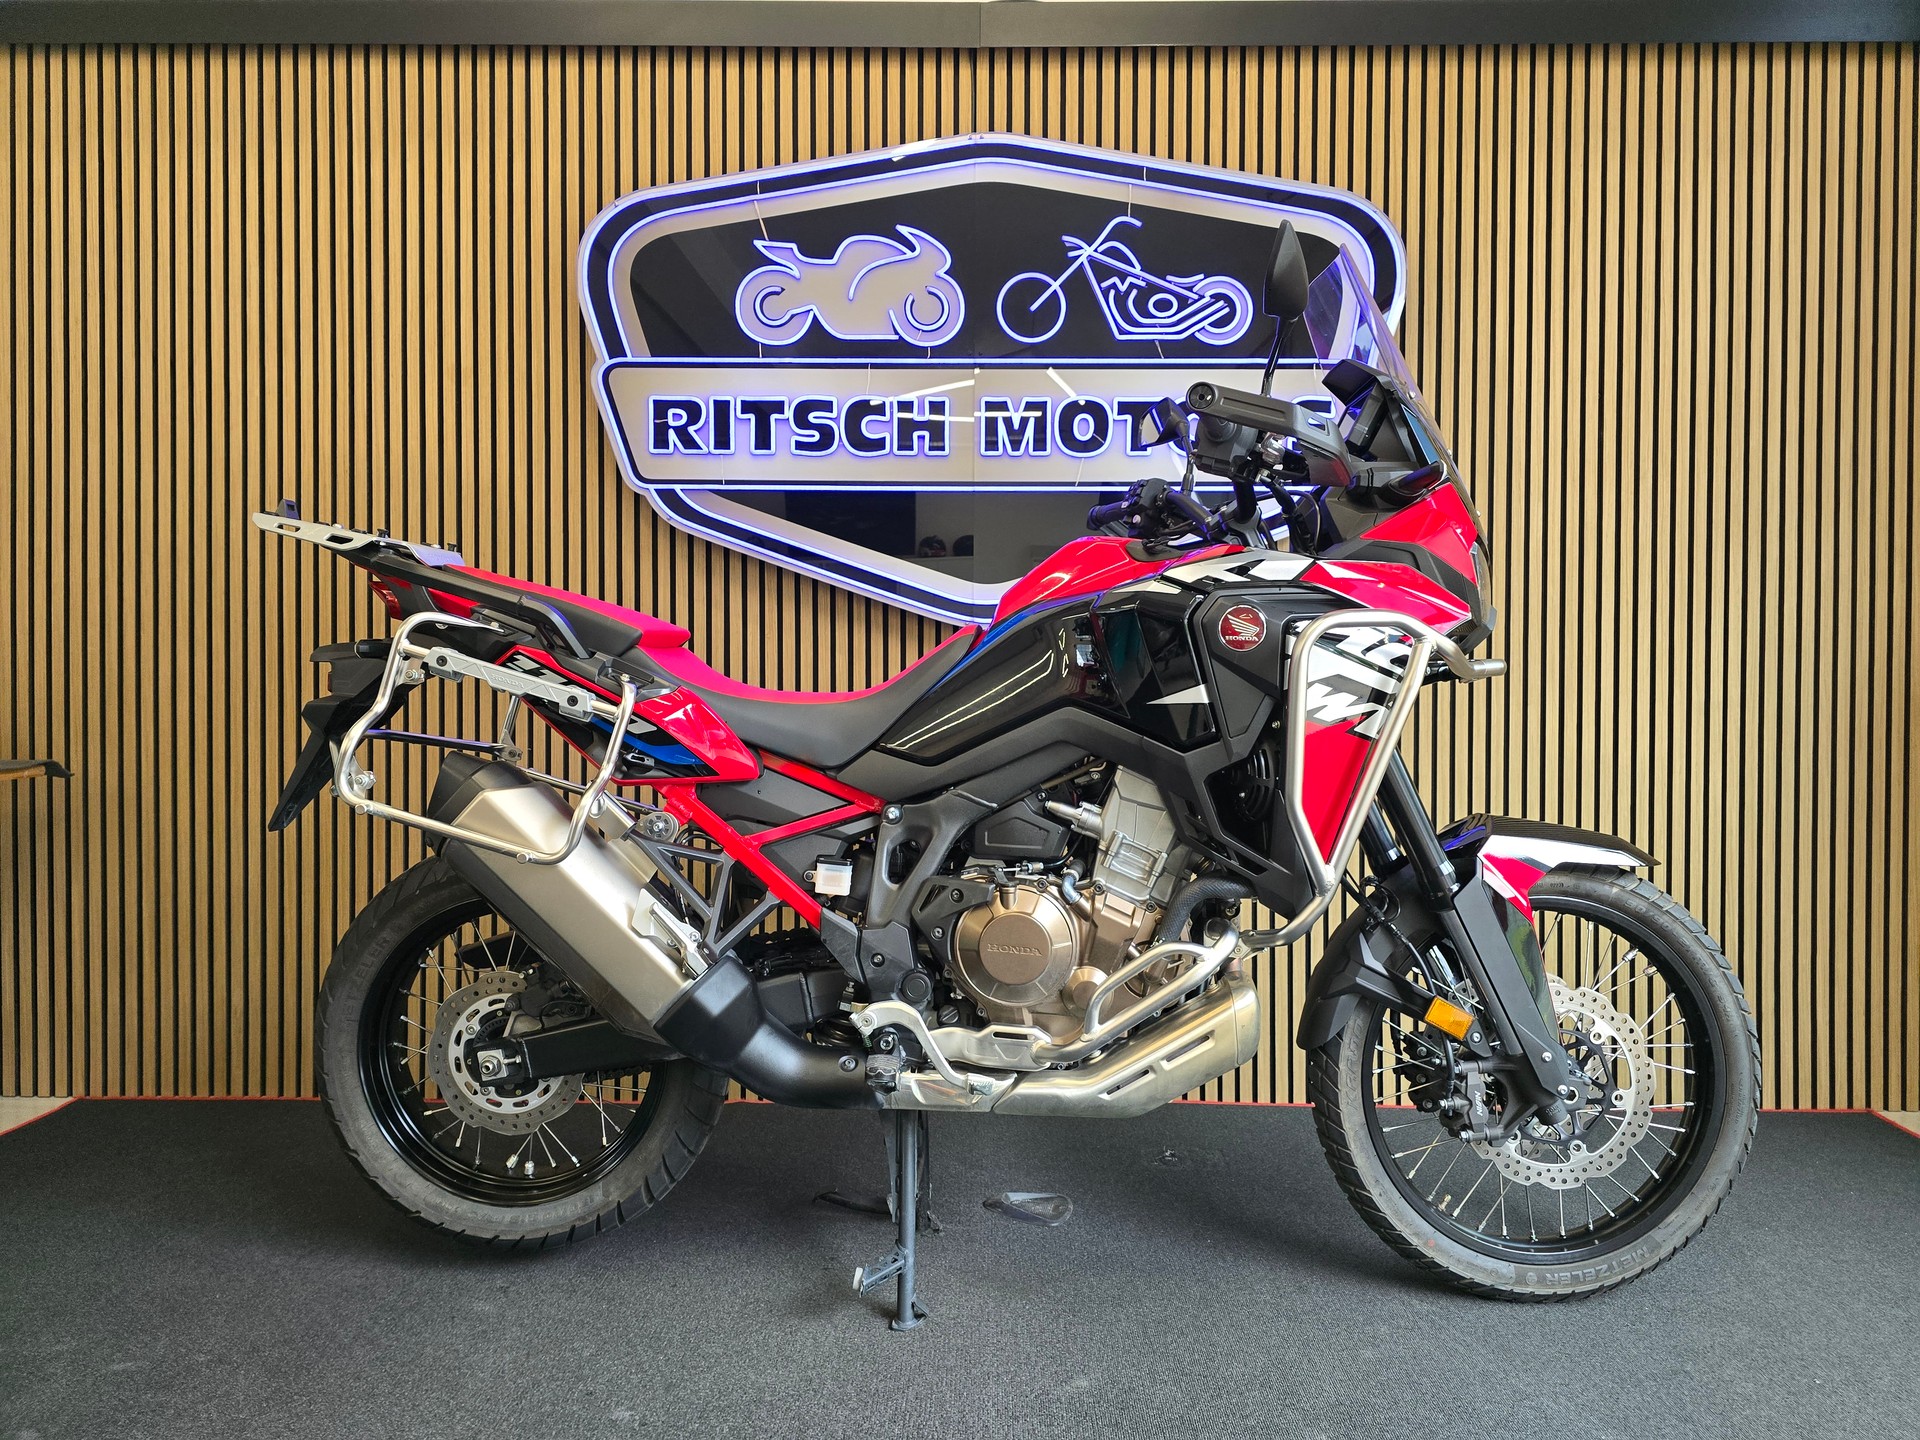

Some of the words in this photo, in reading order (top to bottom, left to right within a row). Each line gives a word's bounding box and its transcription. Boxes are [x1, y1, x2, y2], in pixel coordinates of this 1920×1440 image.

[649, 396, 950, 456] RITSCH
[979, 395, 1336, 458] MOT
[490, 672, 525, 690] HONDA
[986, 943, 1042, 957] HONDA
[1545, 1246, 1650, 1285] METZELER
